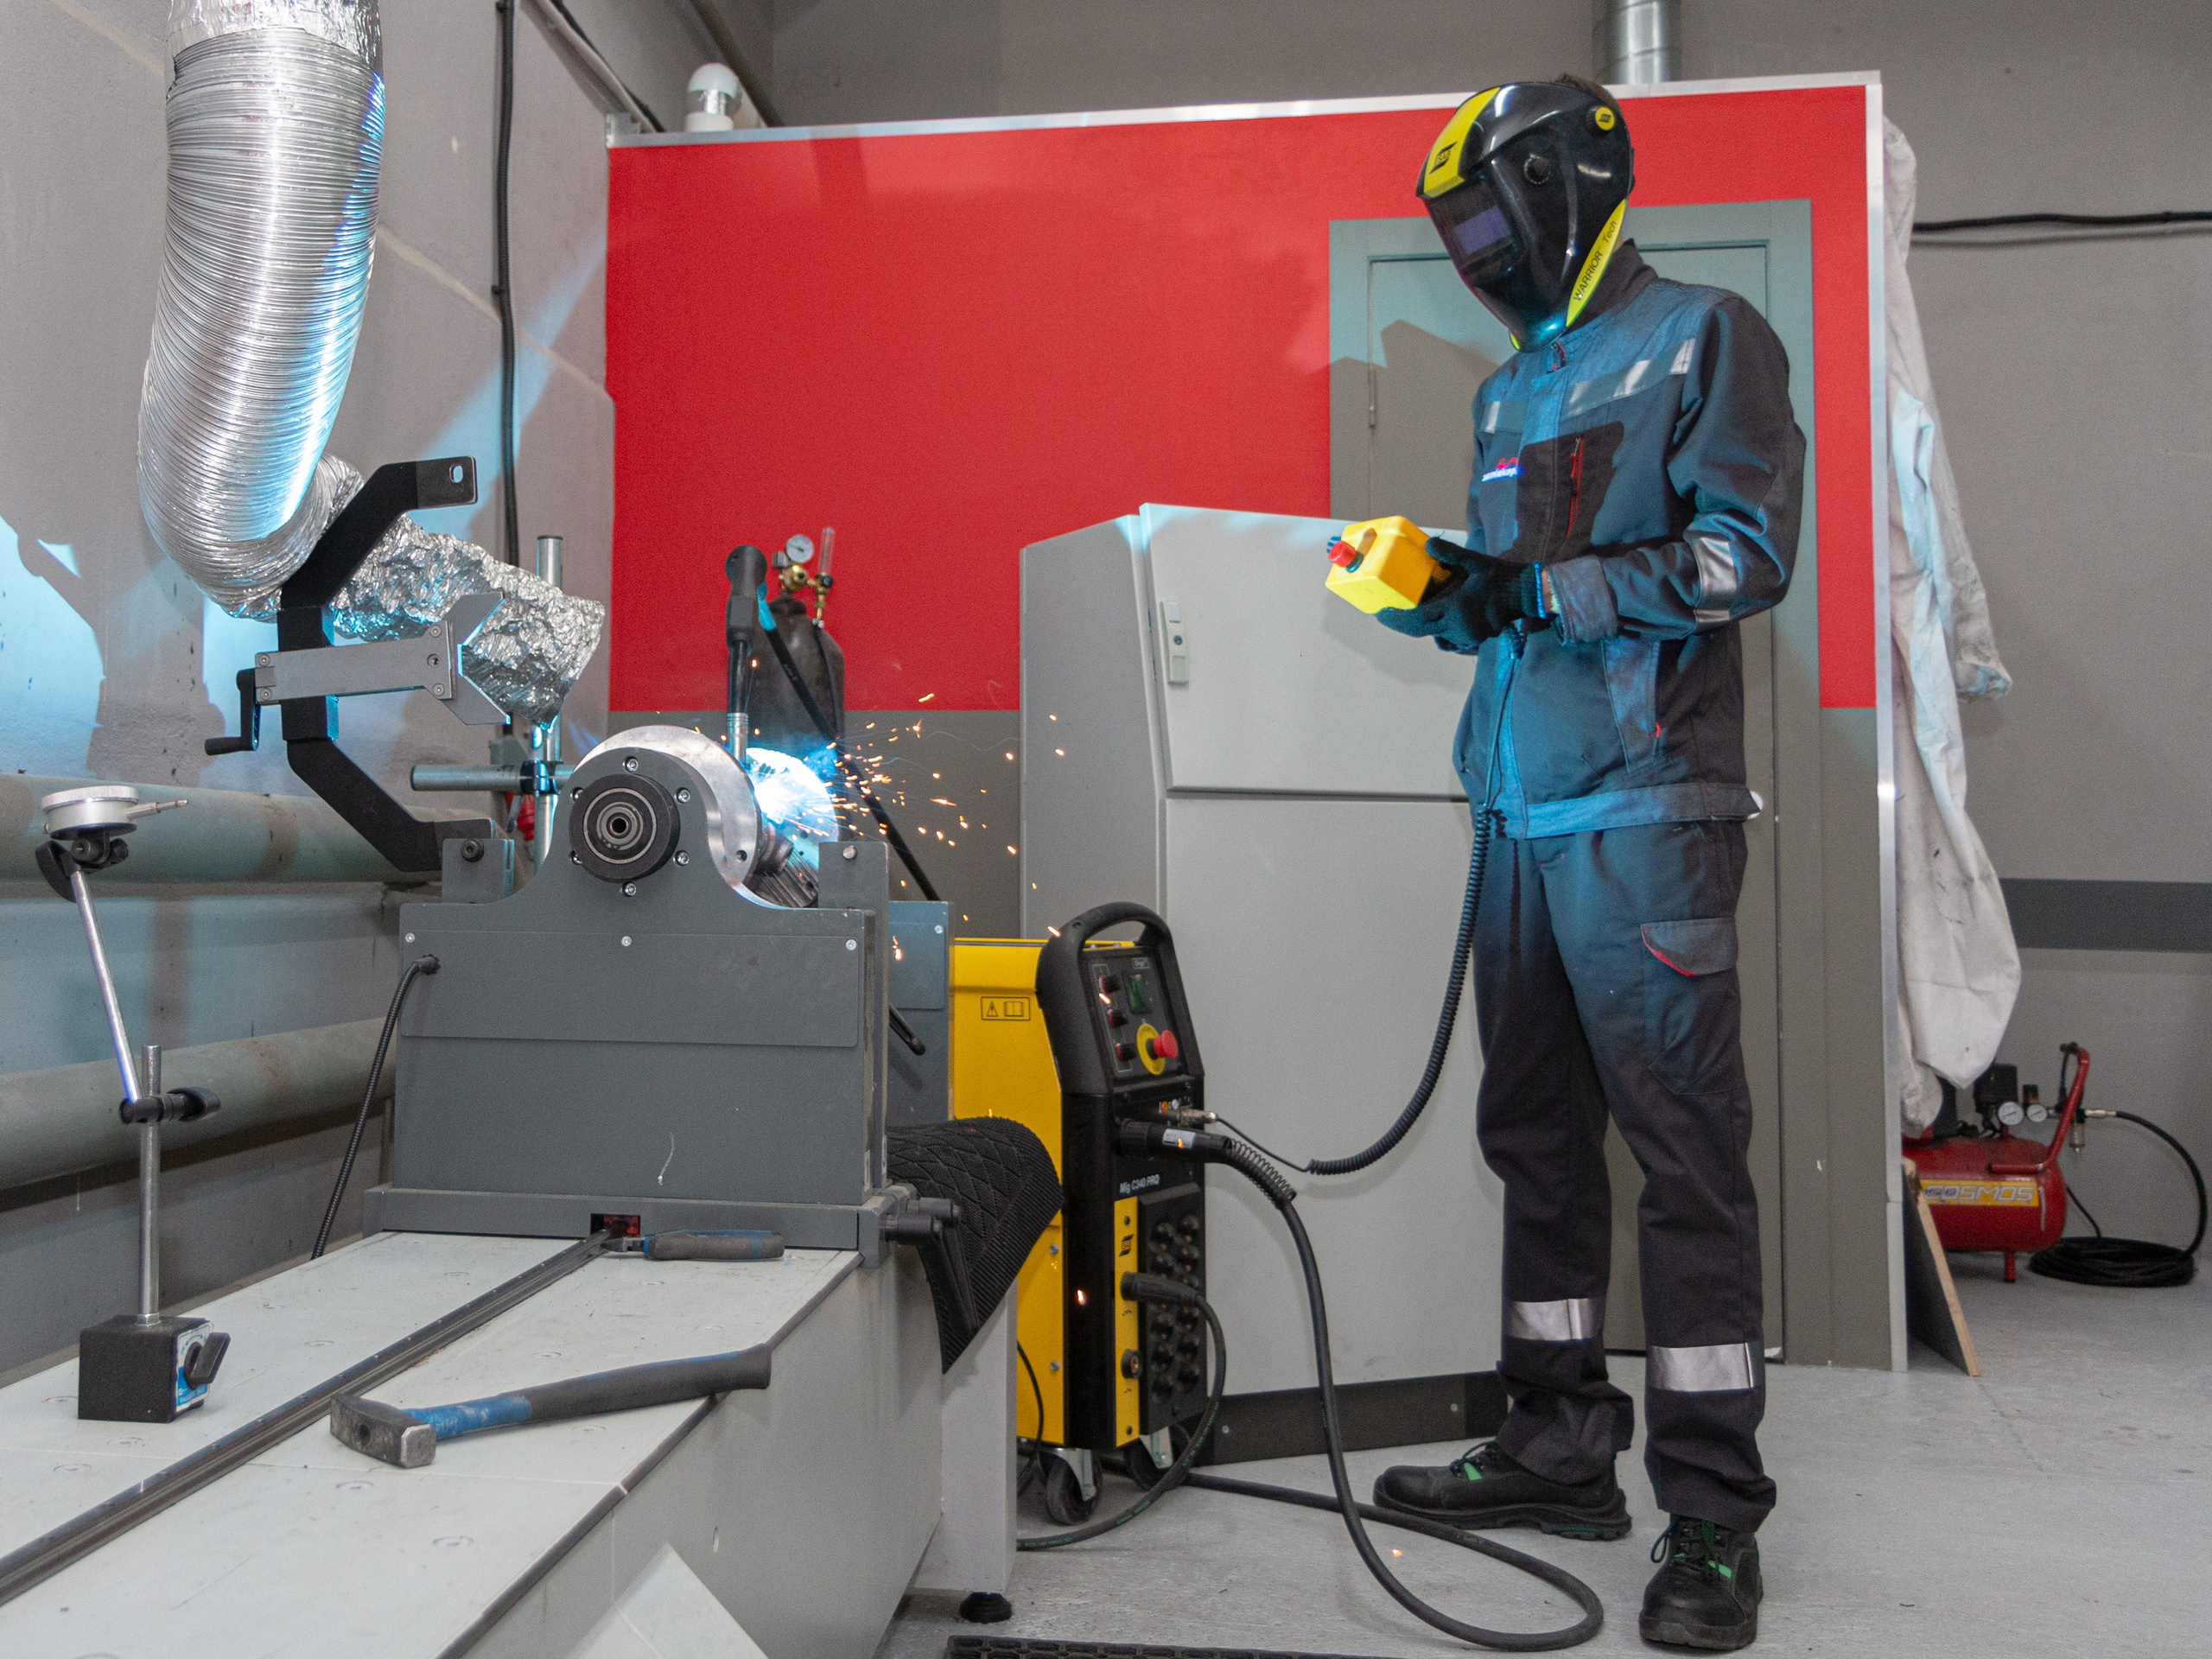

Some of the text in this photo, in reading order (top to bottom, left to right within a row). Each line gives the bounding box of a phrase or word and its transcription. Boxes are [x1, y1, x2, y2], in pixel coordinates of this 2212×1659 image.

[1573, 220, 1617, 301] WARRIOR Tech
[1147, 1173, 1160, 1186] PRO
[1924, 1185, 2034, 1201] COSMOS
